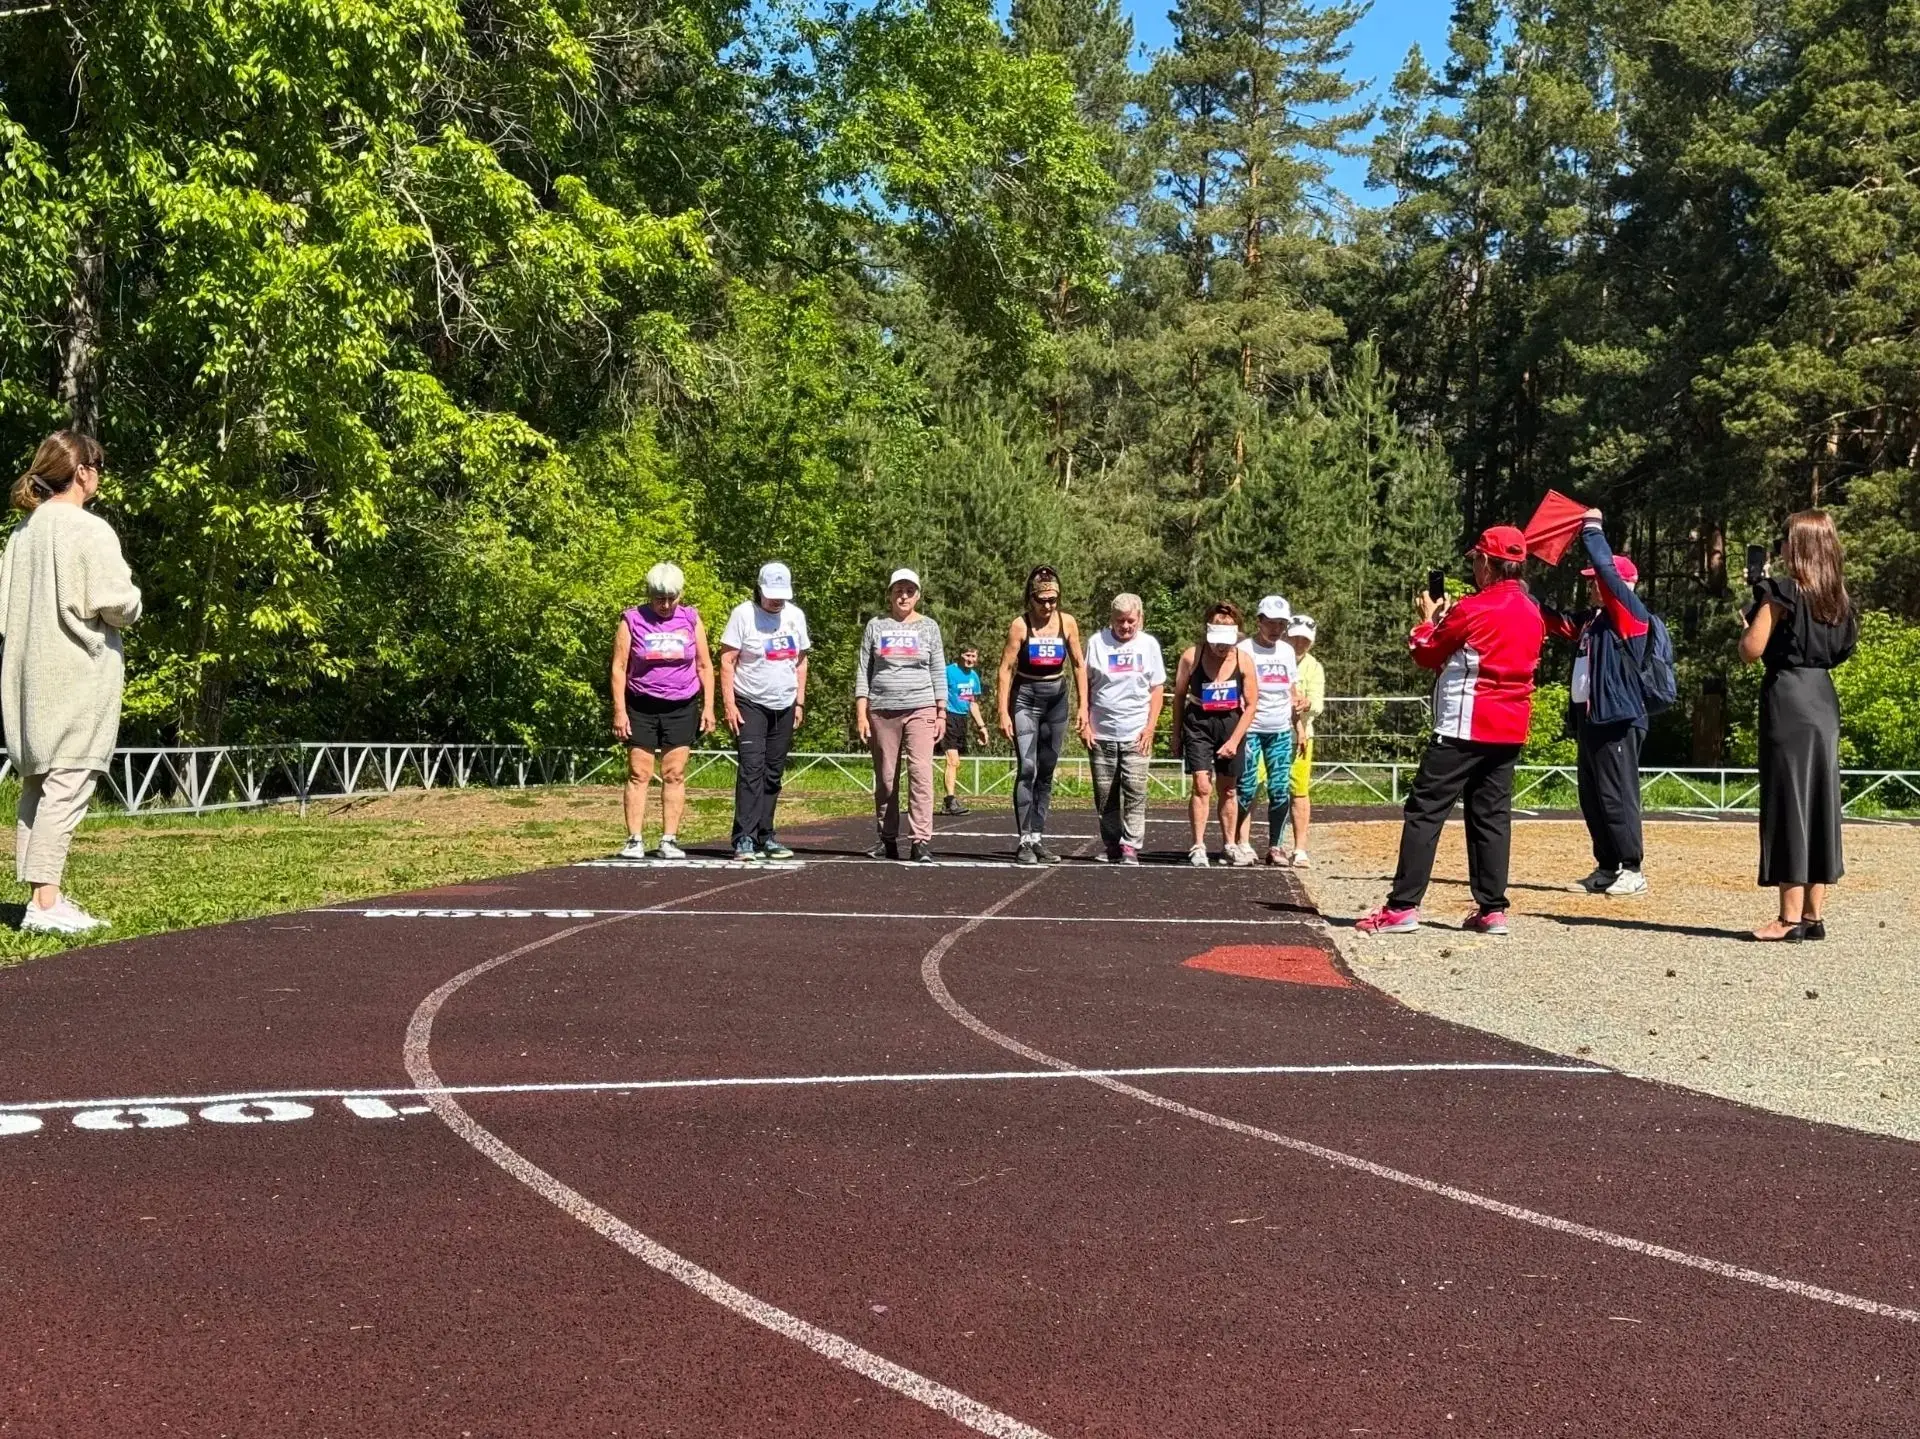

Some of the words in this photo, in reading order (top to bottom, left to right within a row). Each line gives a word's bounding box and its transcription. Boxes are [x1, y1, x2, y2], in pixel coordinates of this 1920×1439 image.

[773, 637, 789, 650] 53
[886, 637, 914, 648] 245
[1038, 645, 1056, 658] 55
[1117, 655, 1133, 666] 57
[1211, 689, 1230, 701] 47
